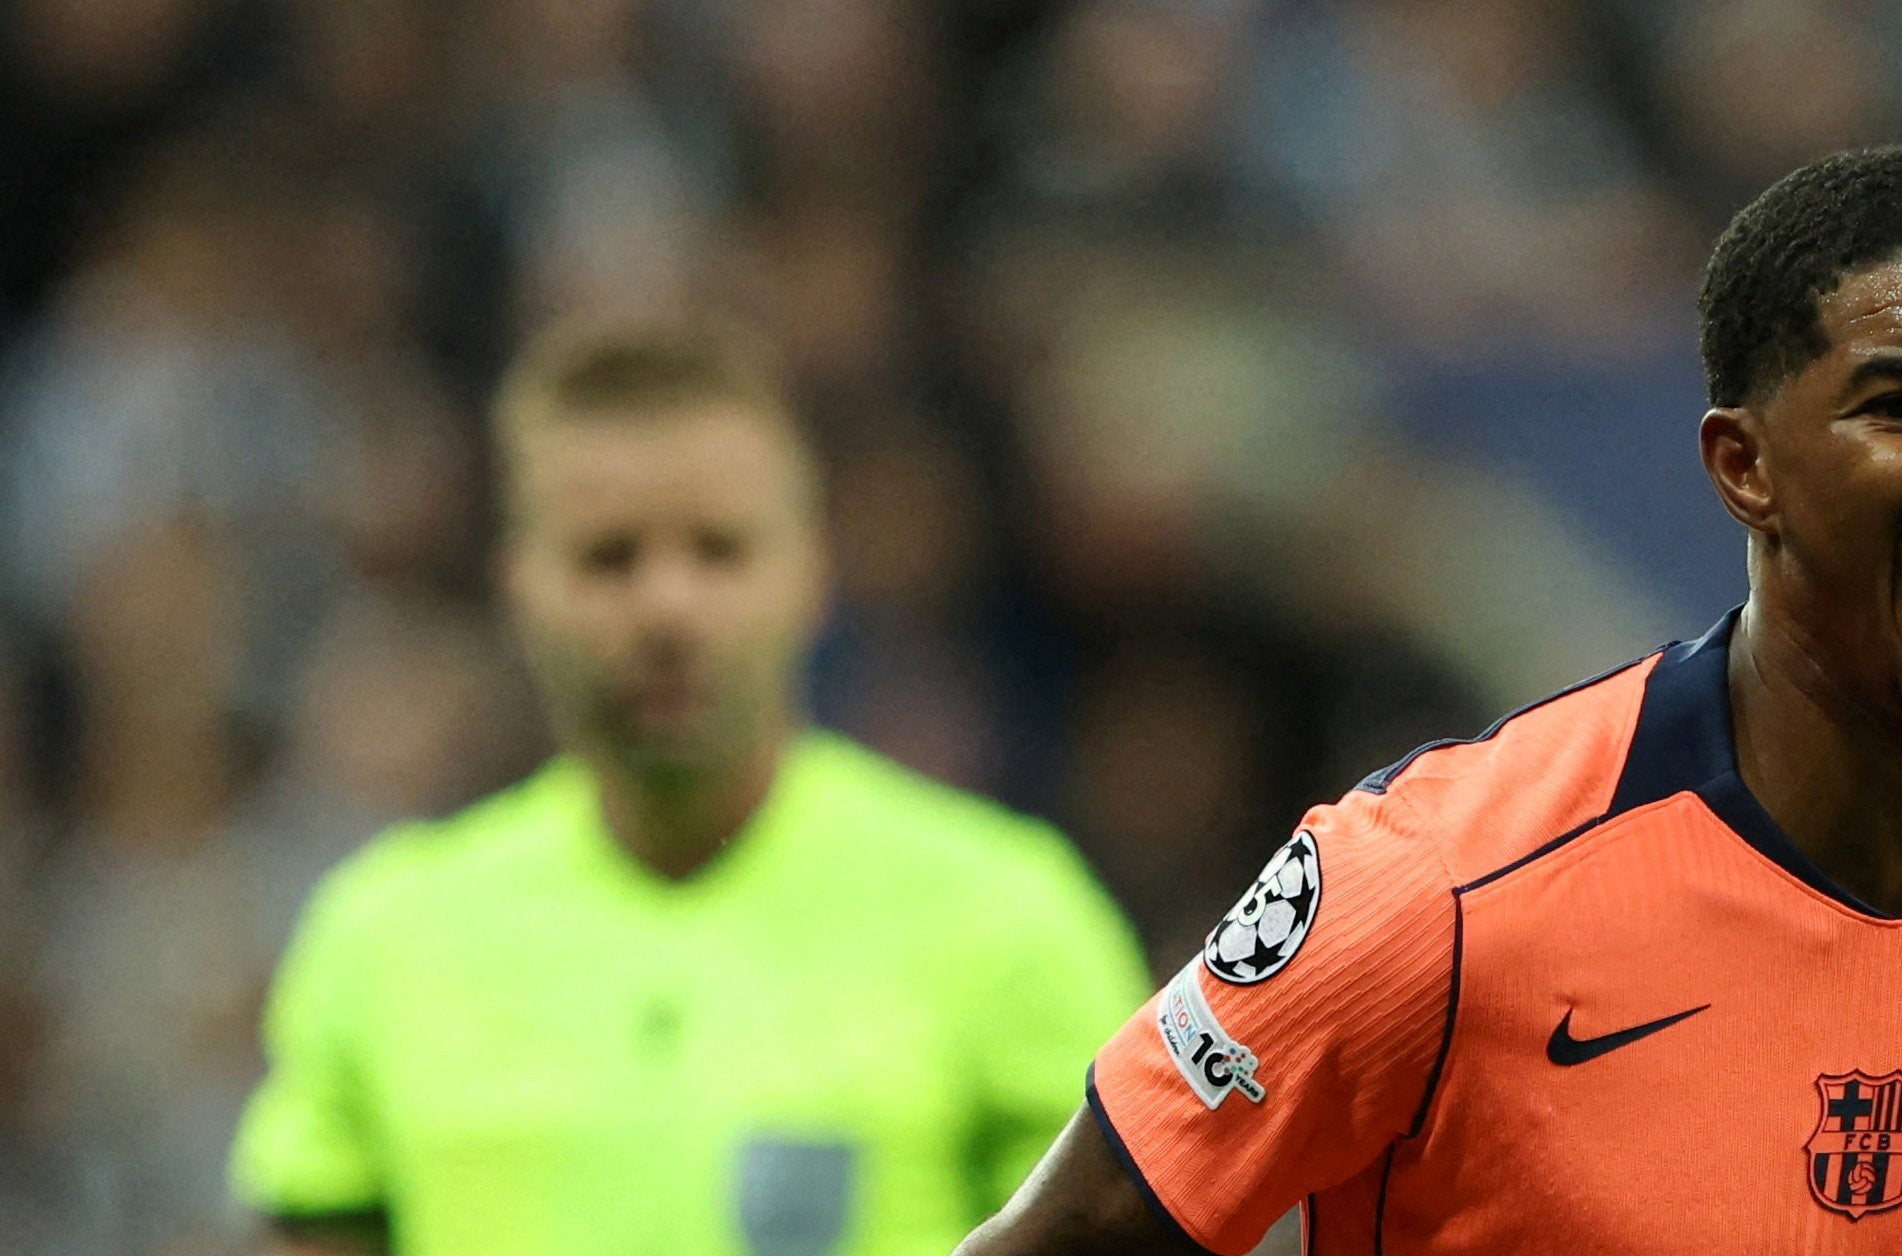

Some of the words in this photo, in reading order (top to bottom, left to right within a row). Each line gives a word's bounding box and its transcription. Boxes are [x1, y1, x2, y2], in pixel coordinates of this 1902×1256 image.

[1237, 875, 1283, 926] 5
[1191, 1032, 1234, 1087] 10
[1235, 1074, 1260, 1098] YEARS
